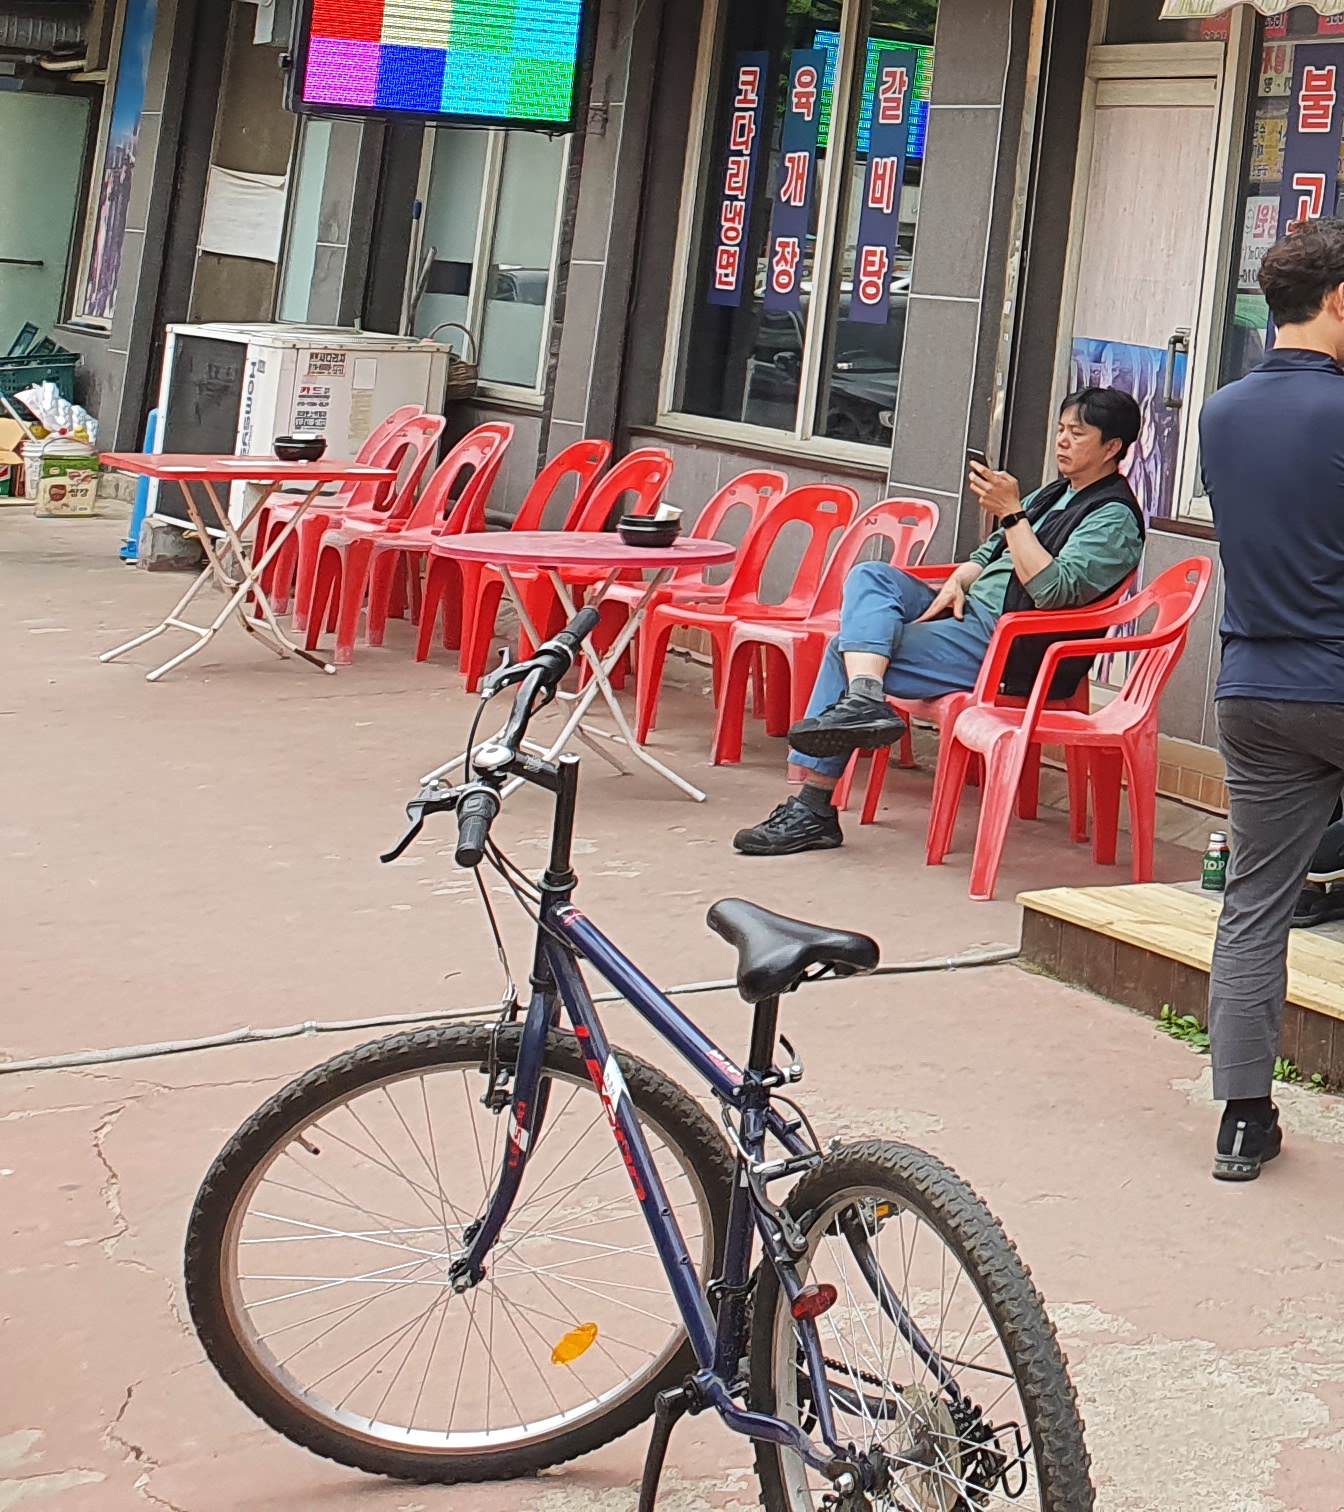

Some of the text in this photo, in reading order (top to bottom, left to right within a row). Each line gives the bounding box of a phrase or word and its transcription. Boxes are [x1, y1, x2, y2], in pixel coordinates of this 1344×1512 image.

[714, 65, 760, 292] 코다리냉면
[772, 65, 818, 294] 육개장
[858, 66, 908, 305] 갈비탕
[1286, 65, 1337, 236] 불고
